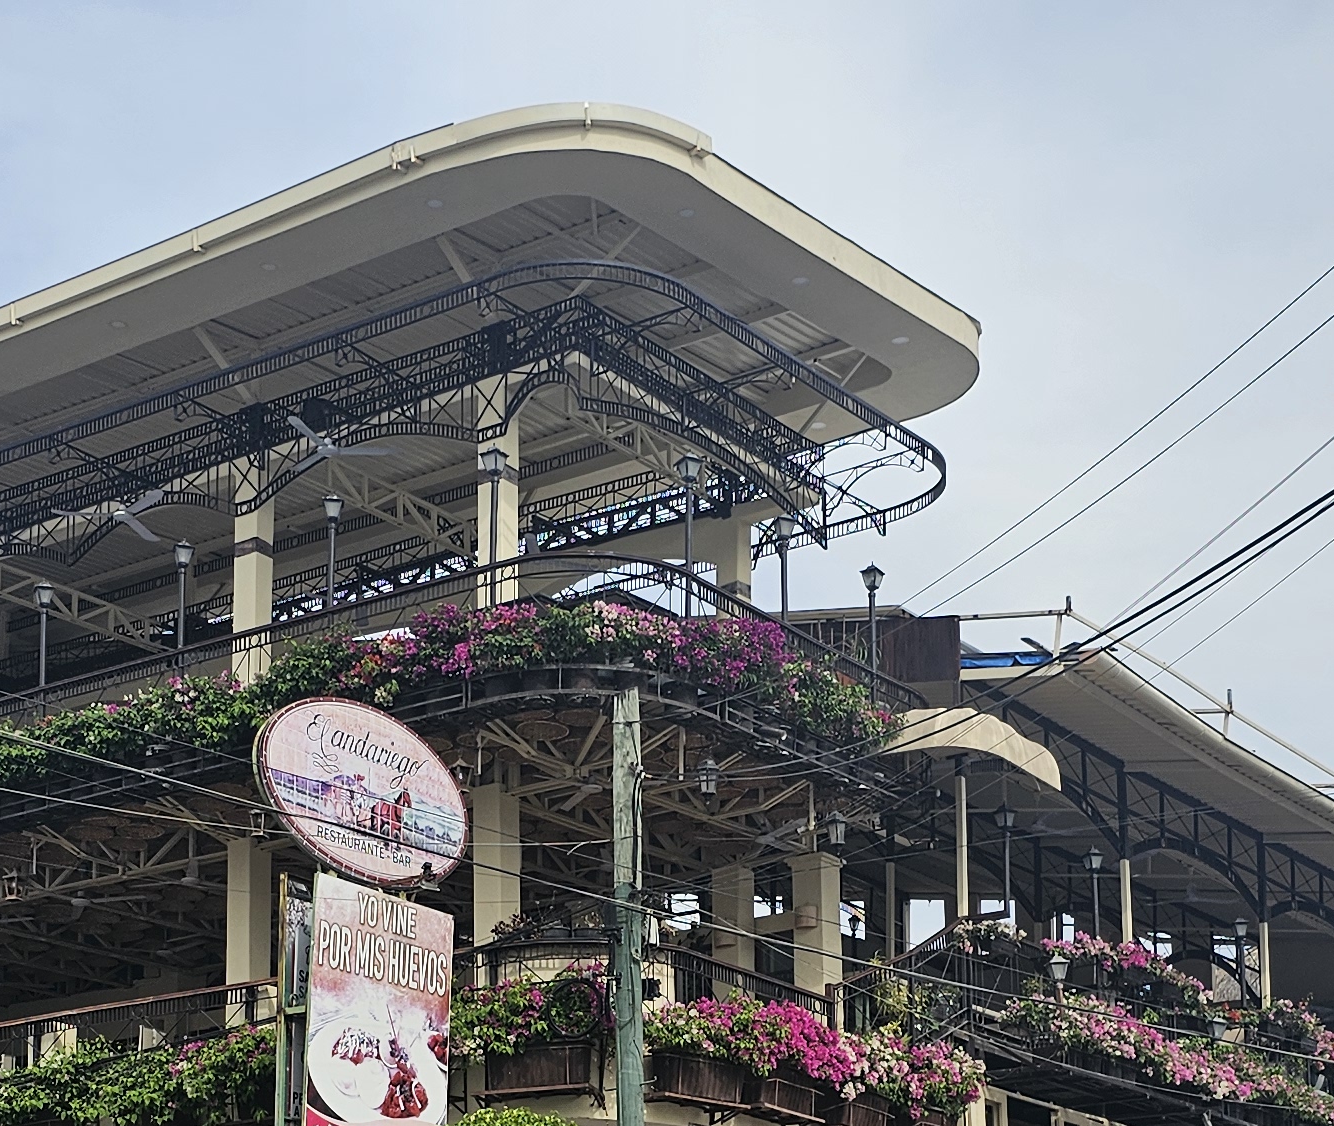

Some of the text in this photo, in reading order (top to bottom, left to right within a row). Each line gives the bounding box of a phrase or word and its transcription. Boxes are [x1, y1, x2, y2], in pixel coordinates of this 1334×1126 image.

[307, 712, 429, 790] El andariego
[317, 824, 385, 860] RESTAURANTE
[392, 850, 411, 869] BAR
[358, 891, 417, 939] YO VINE
[318, 919, 447, 997] POR MIS HUEVOS
